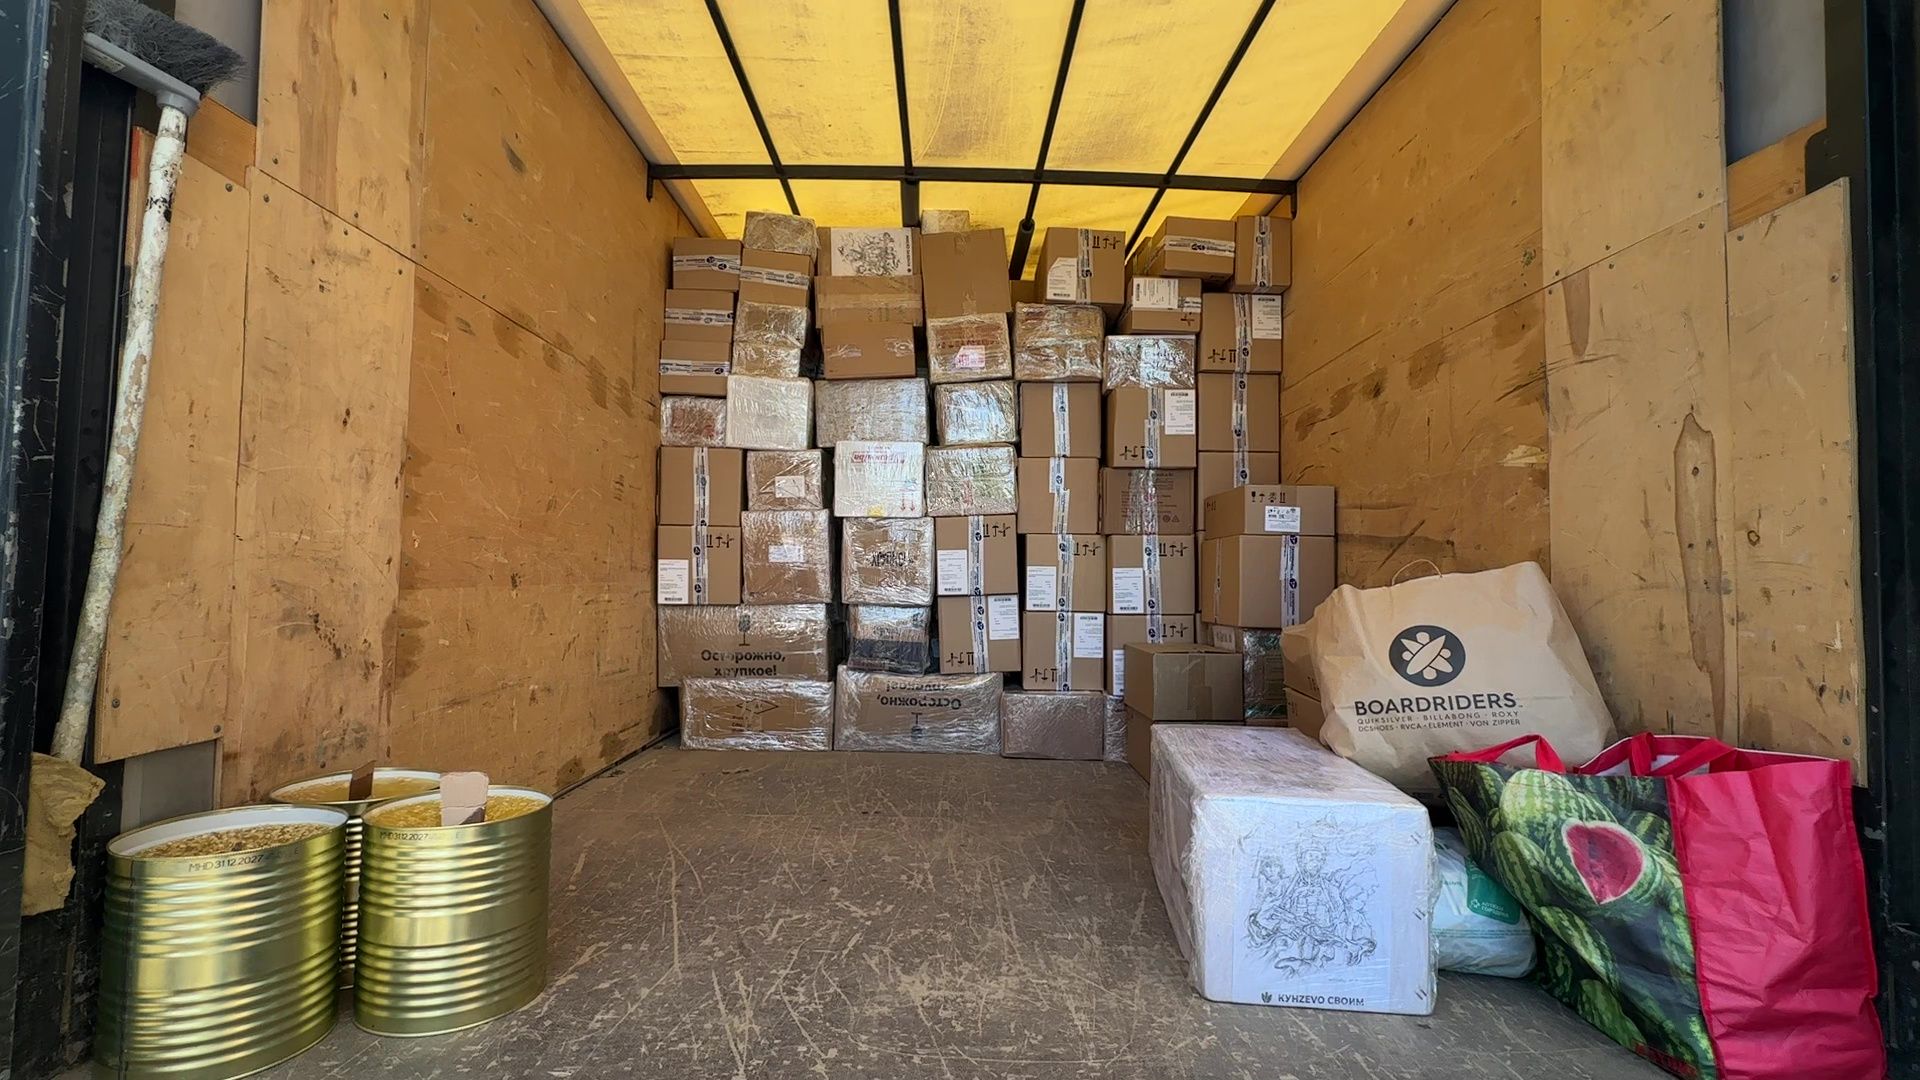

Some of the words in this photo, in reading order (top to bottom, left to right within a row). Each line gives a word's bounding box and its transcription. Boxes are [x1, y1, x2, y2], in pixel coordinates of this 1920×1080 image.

[1354, 692, 1518, 716] BOARDRIDERS
[1423, 712, 1481, 721] BILLABONG
[1491, 710, 1519, 718] ROXY
[1428, 720, 1464, 729] ELEMENT
[1492, 718, 1521, 726] ZIPPER
[1327, 996, 1365, 1006] СВОИМ
